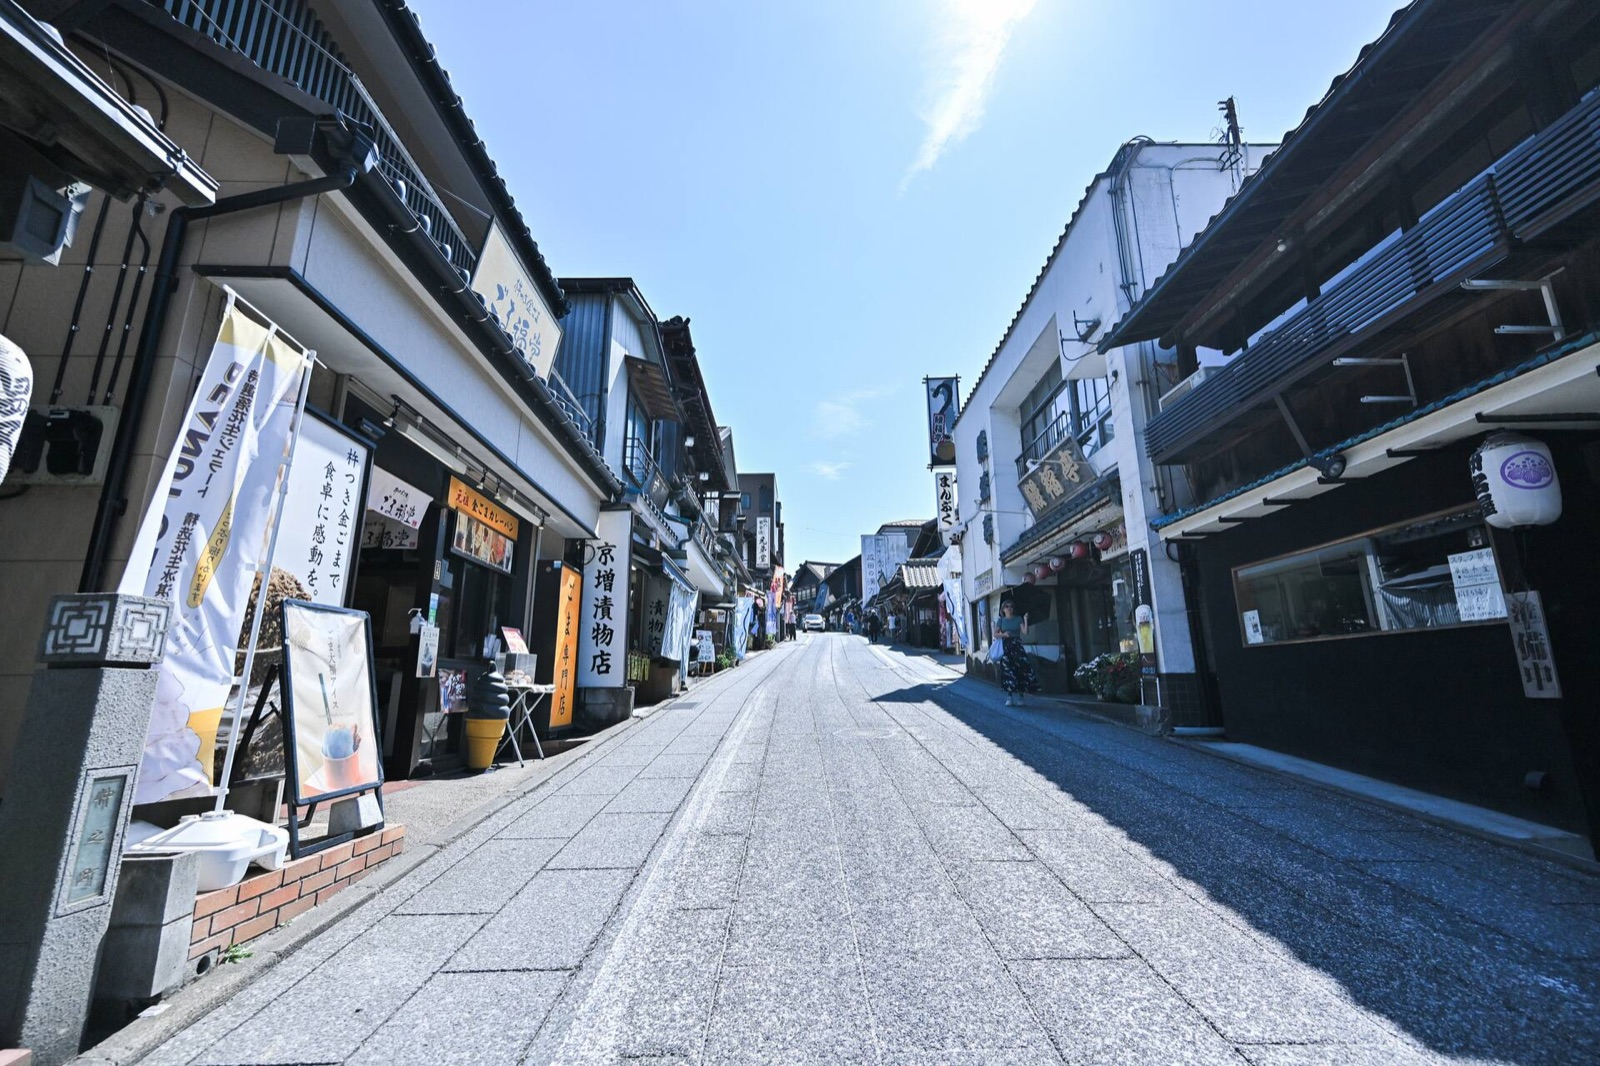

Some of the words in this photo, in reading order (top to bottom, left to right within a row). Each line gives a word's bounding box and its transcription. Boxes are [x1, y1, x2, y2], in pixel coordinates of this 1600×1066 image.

[307, 460, 336, 597] 食卓に感動を。
[330, 447, 359, 588] 杵つき金ごまで
[558, 583, 575, 715] ごま専門店
[590, 541, 617, 676] 京増漬物店
